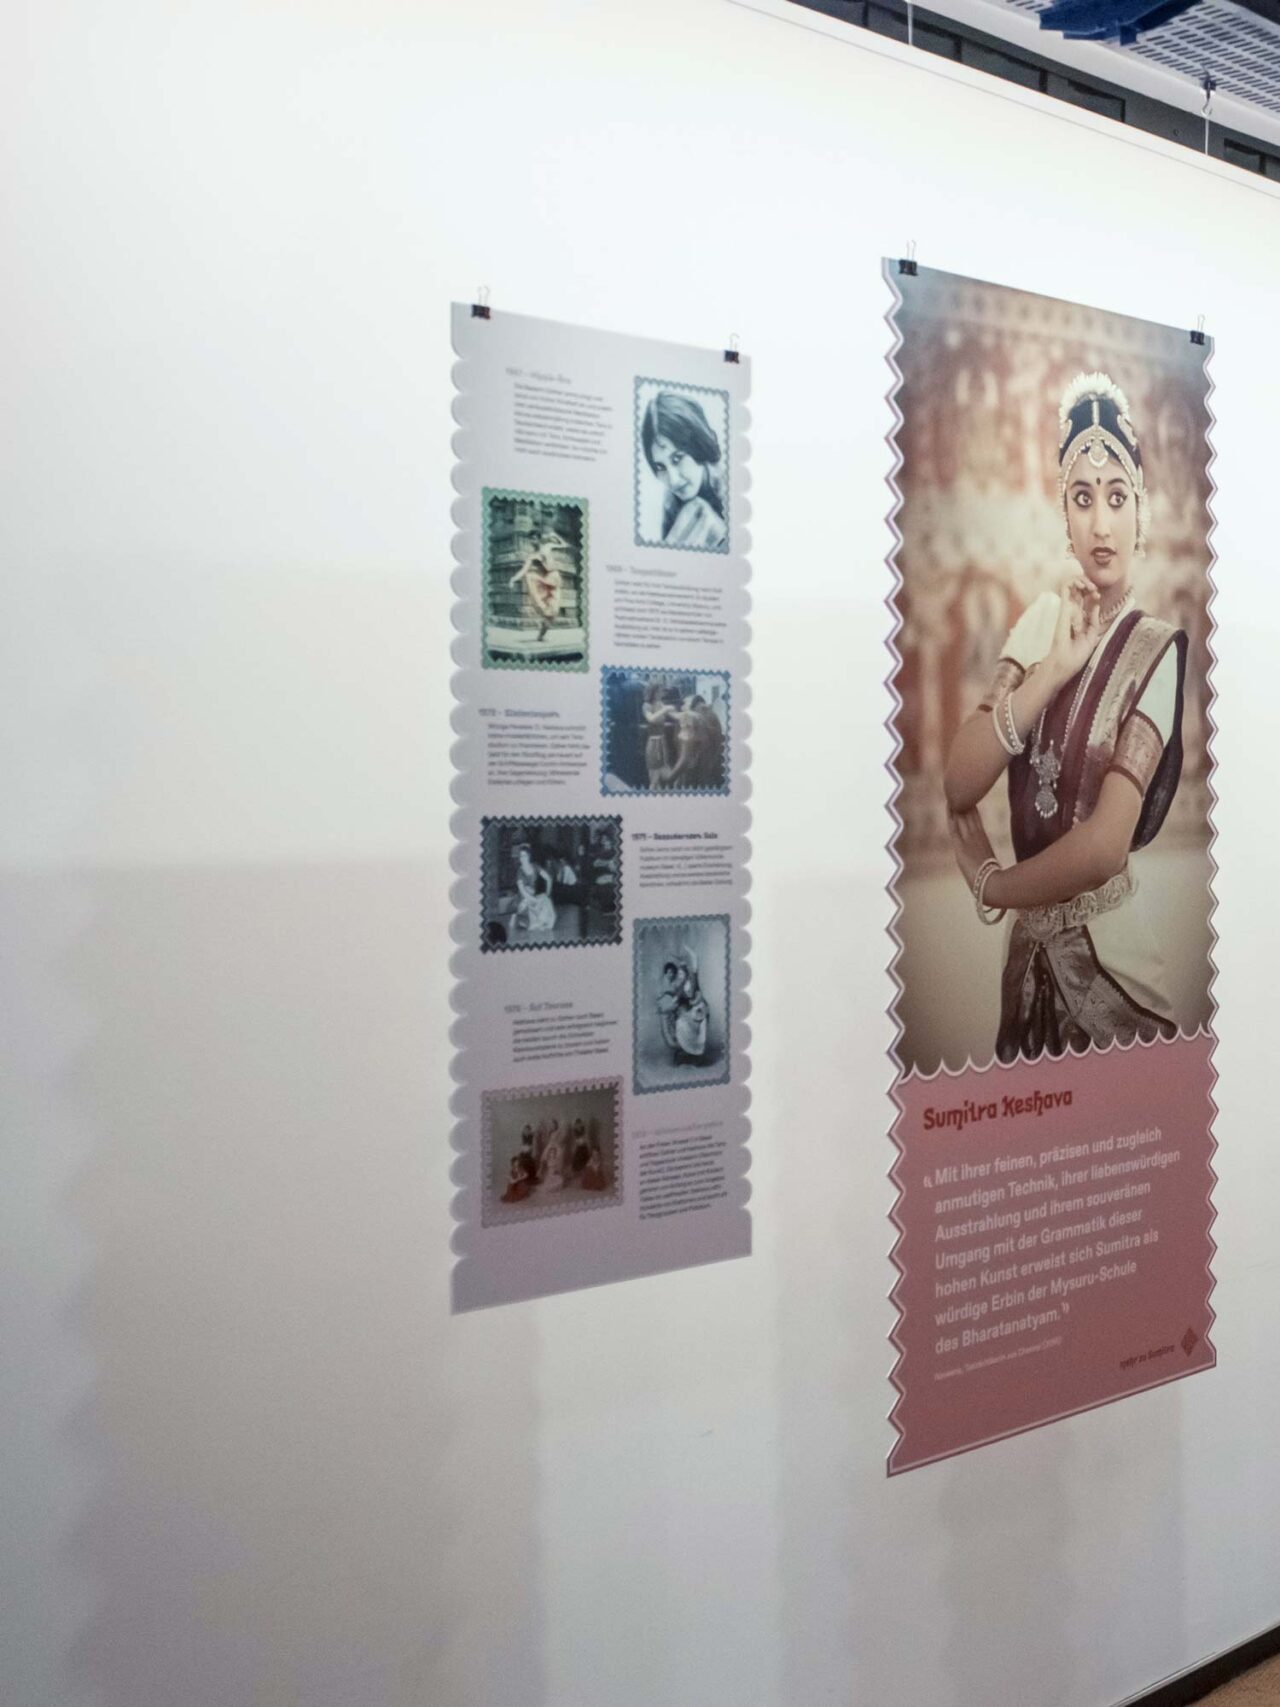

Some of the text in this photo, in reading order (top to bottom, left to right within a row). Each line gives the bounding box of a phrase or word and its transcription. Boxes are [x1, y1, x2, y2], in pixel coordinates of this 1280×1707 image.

[923, 1090, 1073, 1131] Sumitra Keshava
[934, 1150, 1181, 1214] anmutigen Technik, ihrer liebenswürdigen
[935, 1165, 959, 1186] Mit
[961, 1162, 991, 1181] ihrer
[994, 1155, 1037, 1174] feinen,
[1039, 1142, 1089, 1167] präzisen
[1092, 1137, 1114, 1154] und
[1116, 1126, 1162, 1150] zugleich
[934, 1181, 1151, 1243] Ausstrahlung und ihrem souveränen
[935, 1207, 1143, 1270] Umgang mit der Grammatik dieser
[934, 1259, 1137, 1327] würdige Erbin der Mysuru-Schule
[935, 1228, 1159, 1299] hohen Kunst erweist sich Sumitra als
[935, 1336, 959, 1355] des
